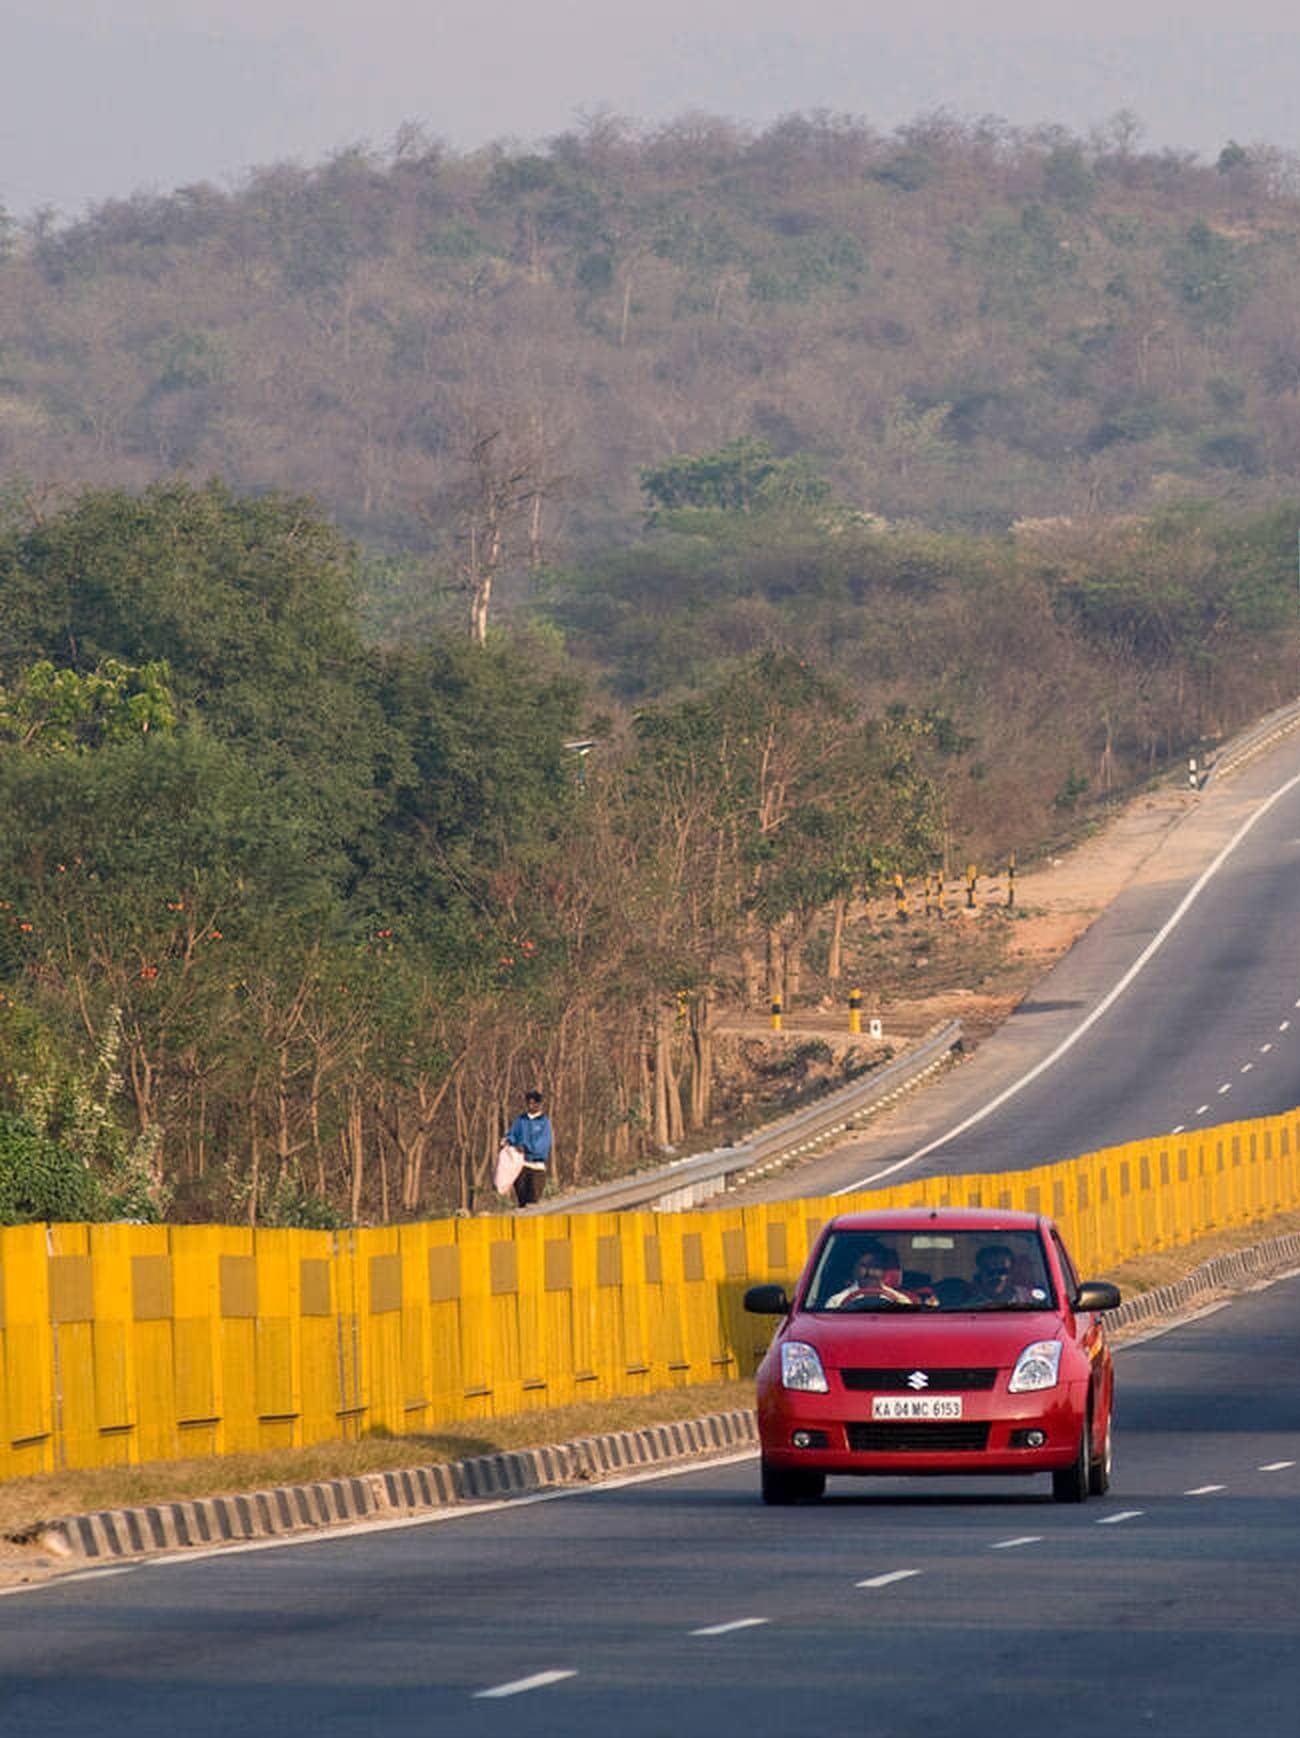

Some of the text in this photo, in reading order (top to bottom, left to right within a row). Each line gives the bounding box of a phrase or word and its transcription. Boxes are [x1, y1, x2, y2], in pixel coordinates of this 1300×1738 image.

[874, 1401, 960, 1416] KA 04 MC 6153
